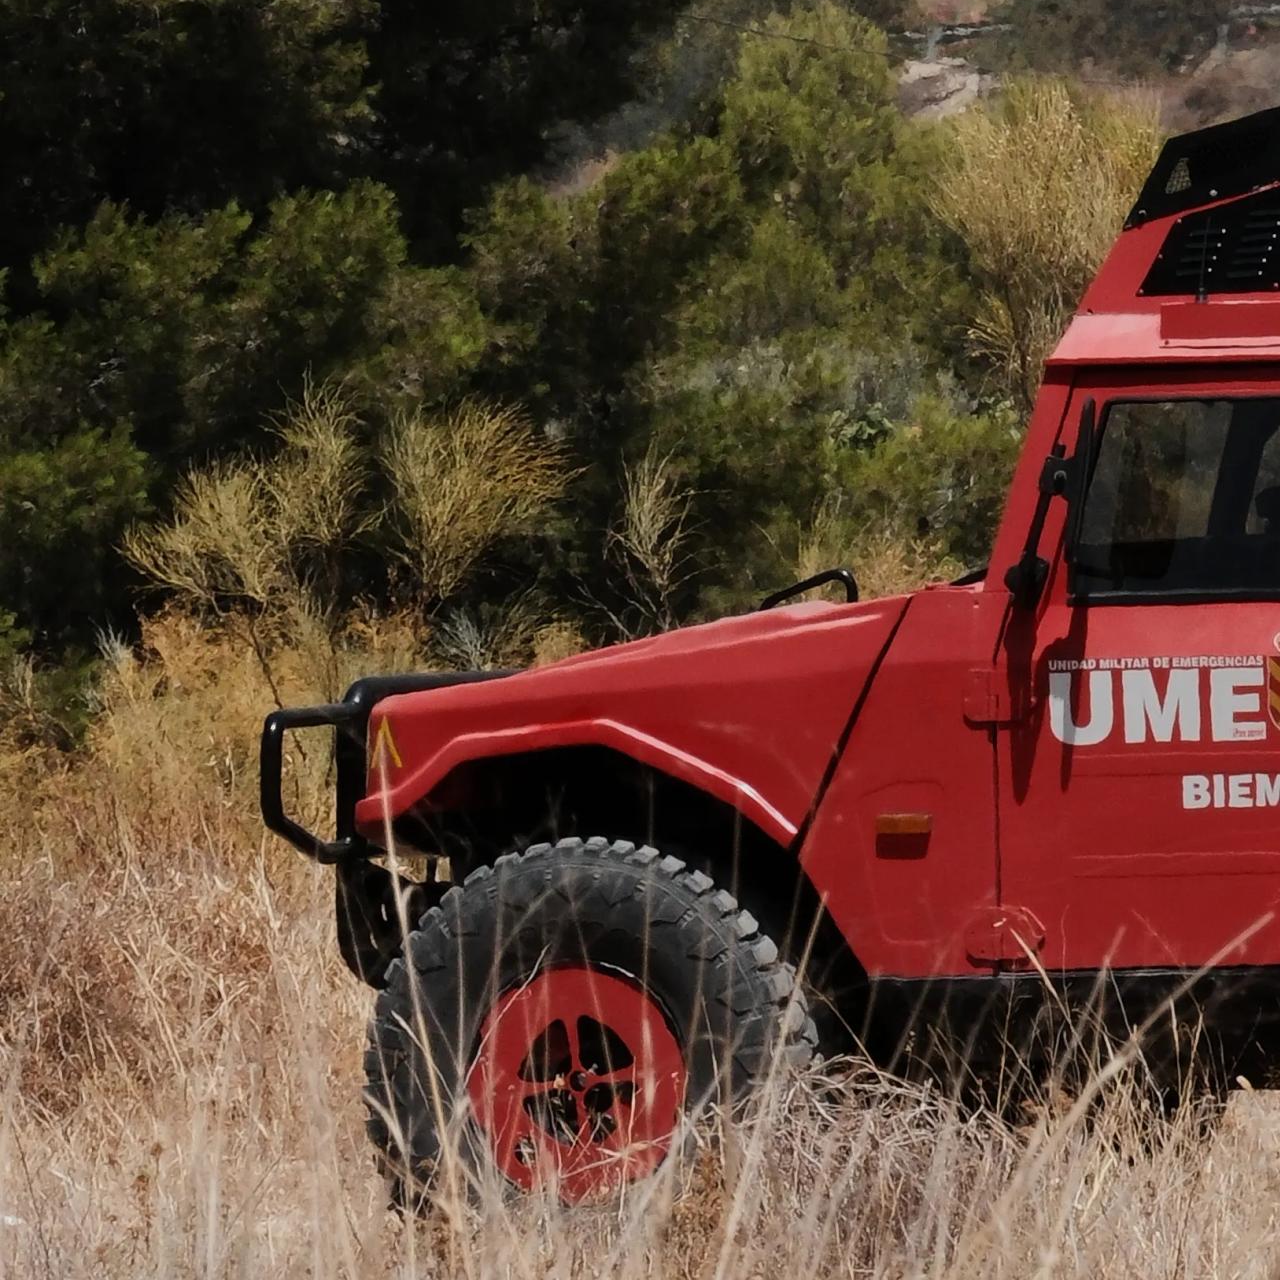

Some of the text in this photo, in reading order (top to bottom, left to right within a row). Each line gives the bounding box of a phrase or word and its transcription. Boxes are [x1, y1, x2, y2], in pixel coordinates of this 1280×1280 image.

[1048, 655, 1263, 671] UNIDAD MILITAR DE EMERGENCIAS
[1048, 667, 1267, 746] UME
